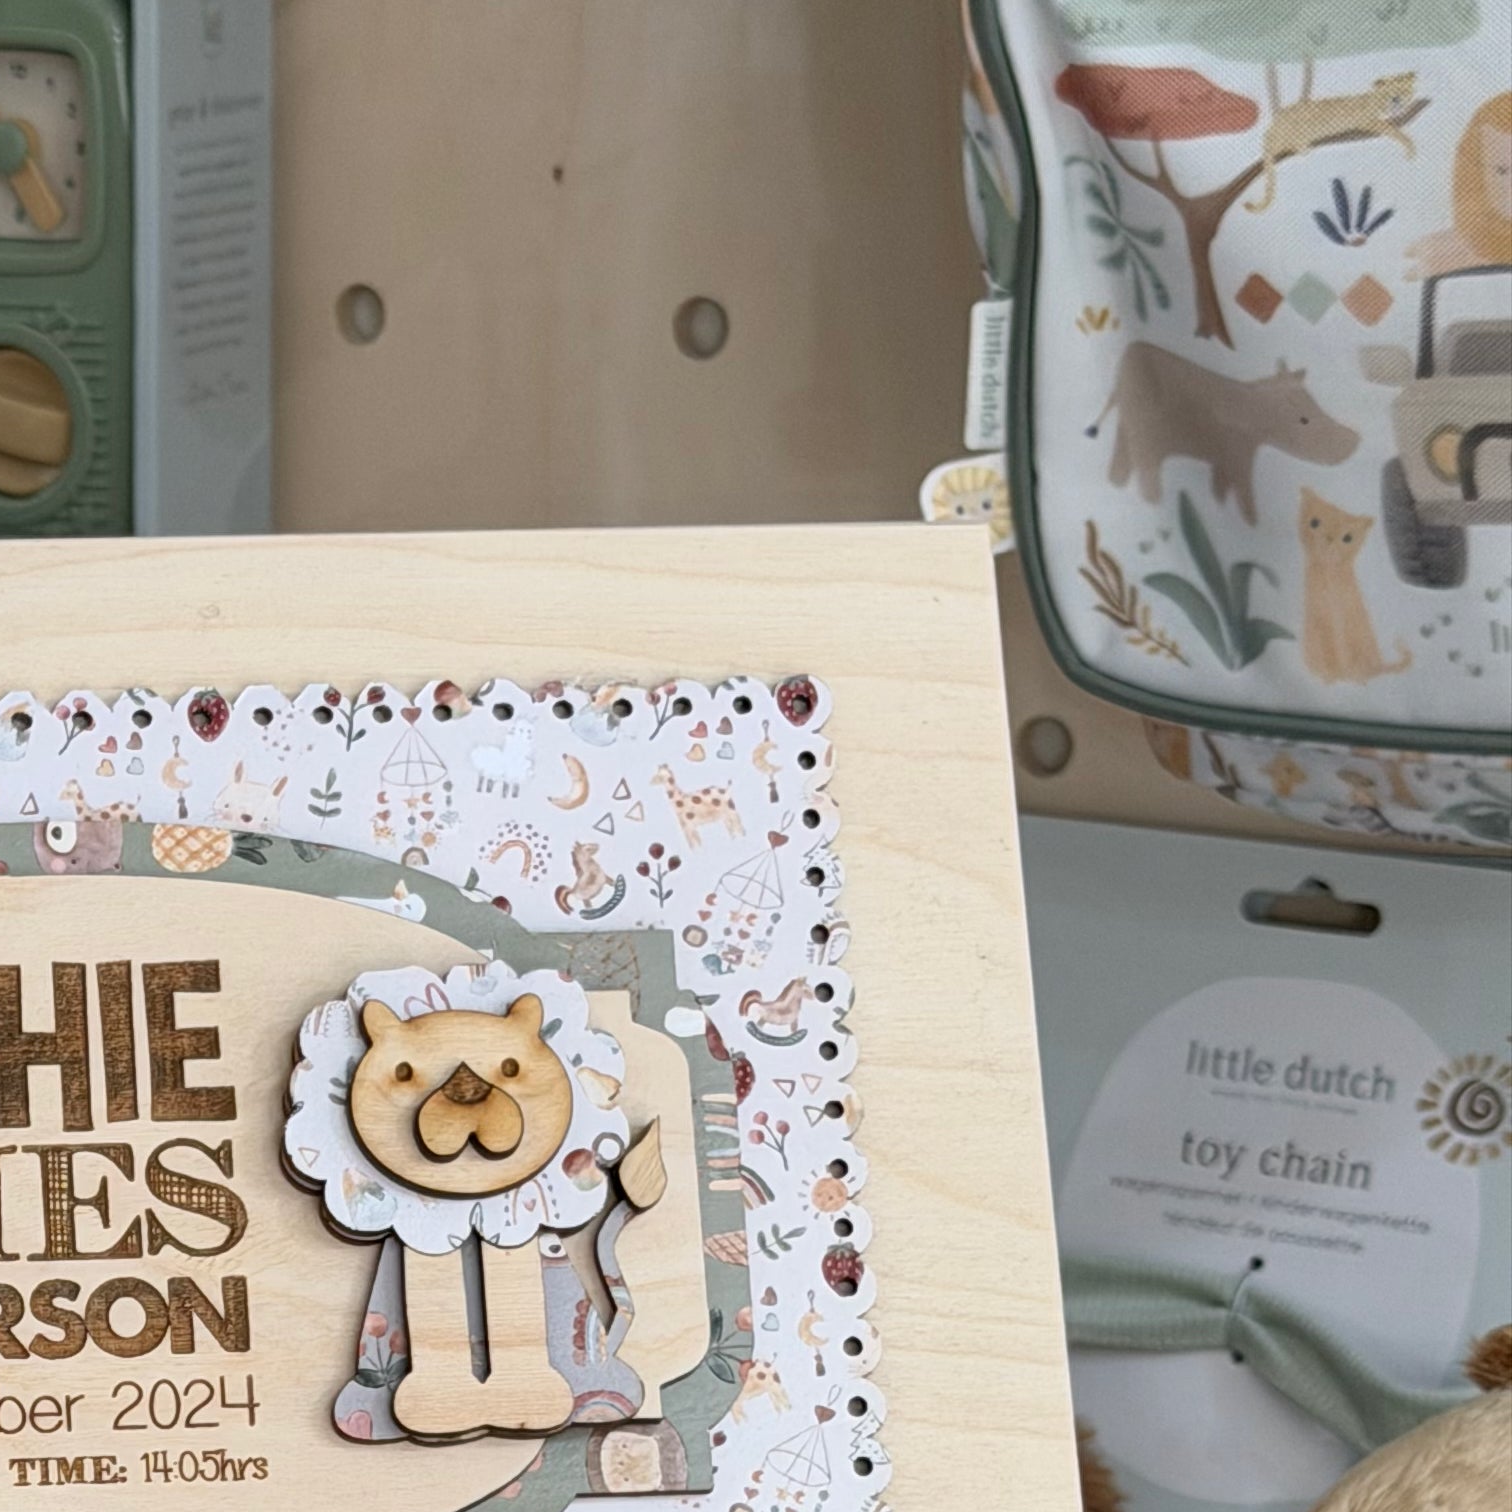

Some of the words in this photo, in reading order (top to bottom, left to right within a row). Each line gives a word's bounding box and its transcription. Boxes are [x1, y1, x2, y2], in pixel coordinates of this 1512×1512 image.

[1185, 1040, 1275, 1087] little
[1283, 1055, 1397, 1104] dutch
[1180, 1130, 1247, 1181] toy
[1258, 1140, 1373, 1191] chain
[111, 1374, 261, 1431] 2024
[8, 1455, 128, 1487] TIME:
[140, 1448, 269, 1483] 14:05hrs
